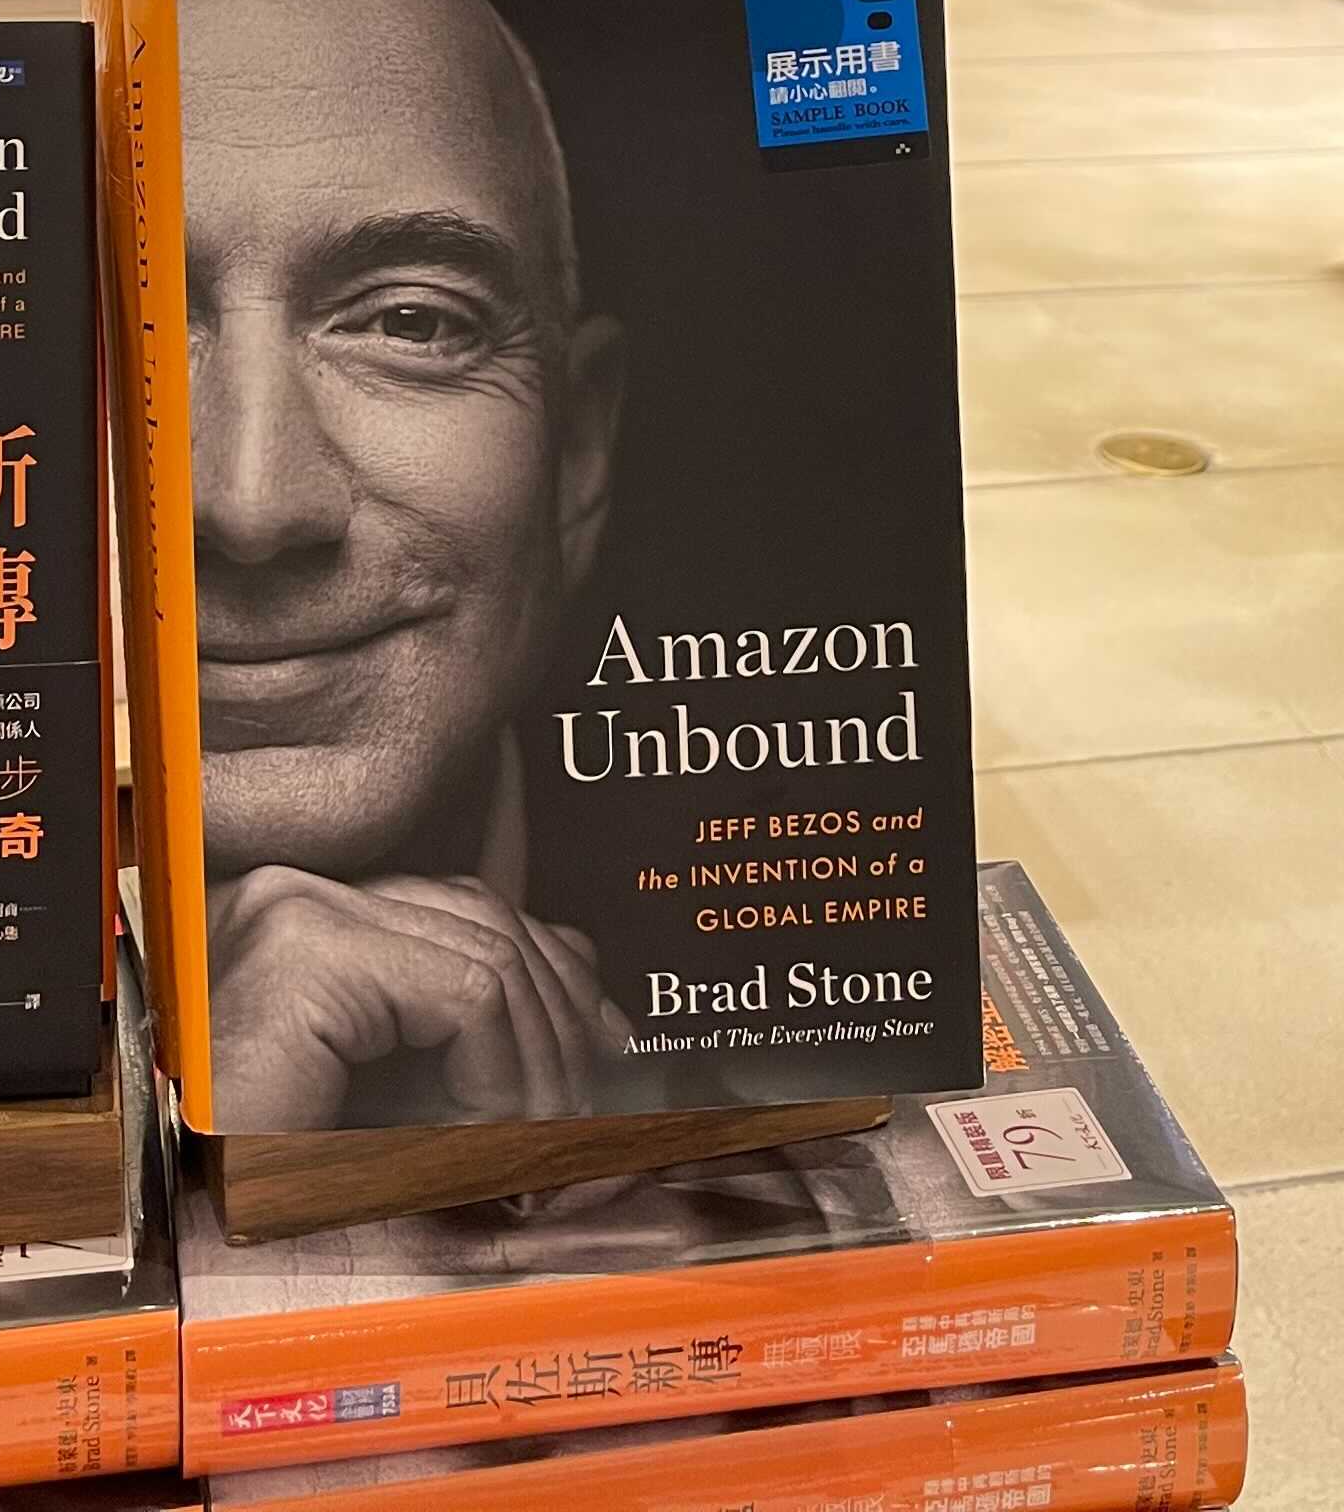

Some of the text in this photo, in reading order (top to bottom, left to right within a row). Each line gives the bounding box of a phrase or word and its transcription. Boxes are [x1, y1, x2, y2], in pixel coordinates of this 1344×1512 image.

[766, 41, 902, 83] 展示用書
[771, 98, 910, 126] SAMPLE BOOK
[14, 299, 26, 312] a
[586, 614, 919, 686] Amazon
[552, 691, 924, 782] Unbound
[695, 806, 924, 843] JEFF BEZOS and
[638, 853, 924, 891] the INVENTION of a
[696, 896, 927, 932] GLOBAL EMPIRE
[646, 962, 933, 1018] Brad Stone
[623, 1018, 934, 1055] Author of The Everything Store
[1002, 1125, 1077, 1170] 79
[1146, 1269, 1166, 1322] Stone
[901, 1322, 1037, 1358] 亞馬遜帝國
[444, 1334, 743, 1410] 貝佐斯新傳
[82, 1375, 101, 1433] Stone
[224, 1394, 328, 1430] 天下文化
[82, 1436, 101, 1471] Brad
